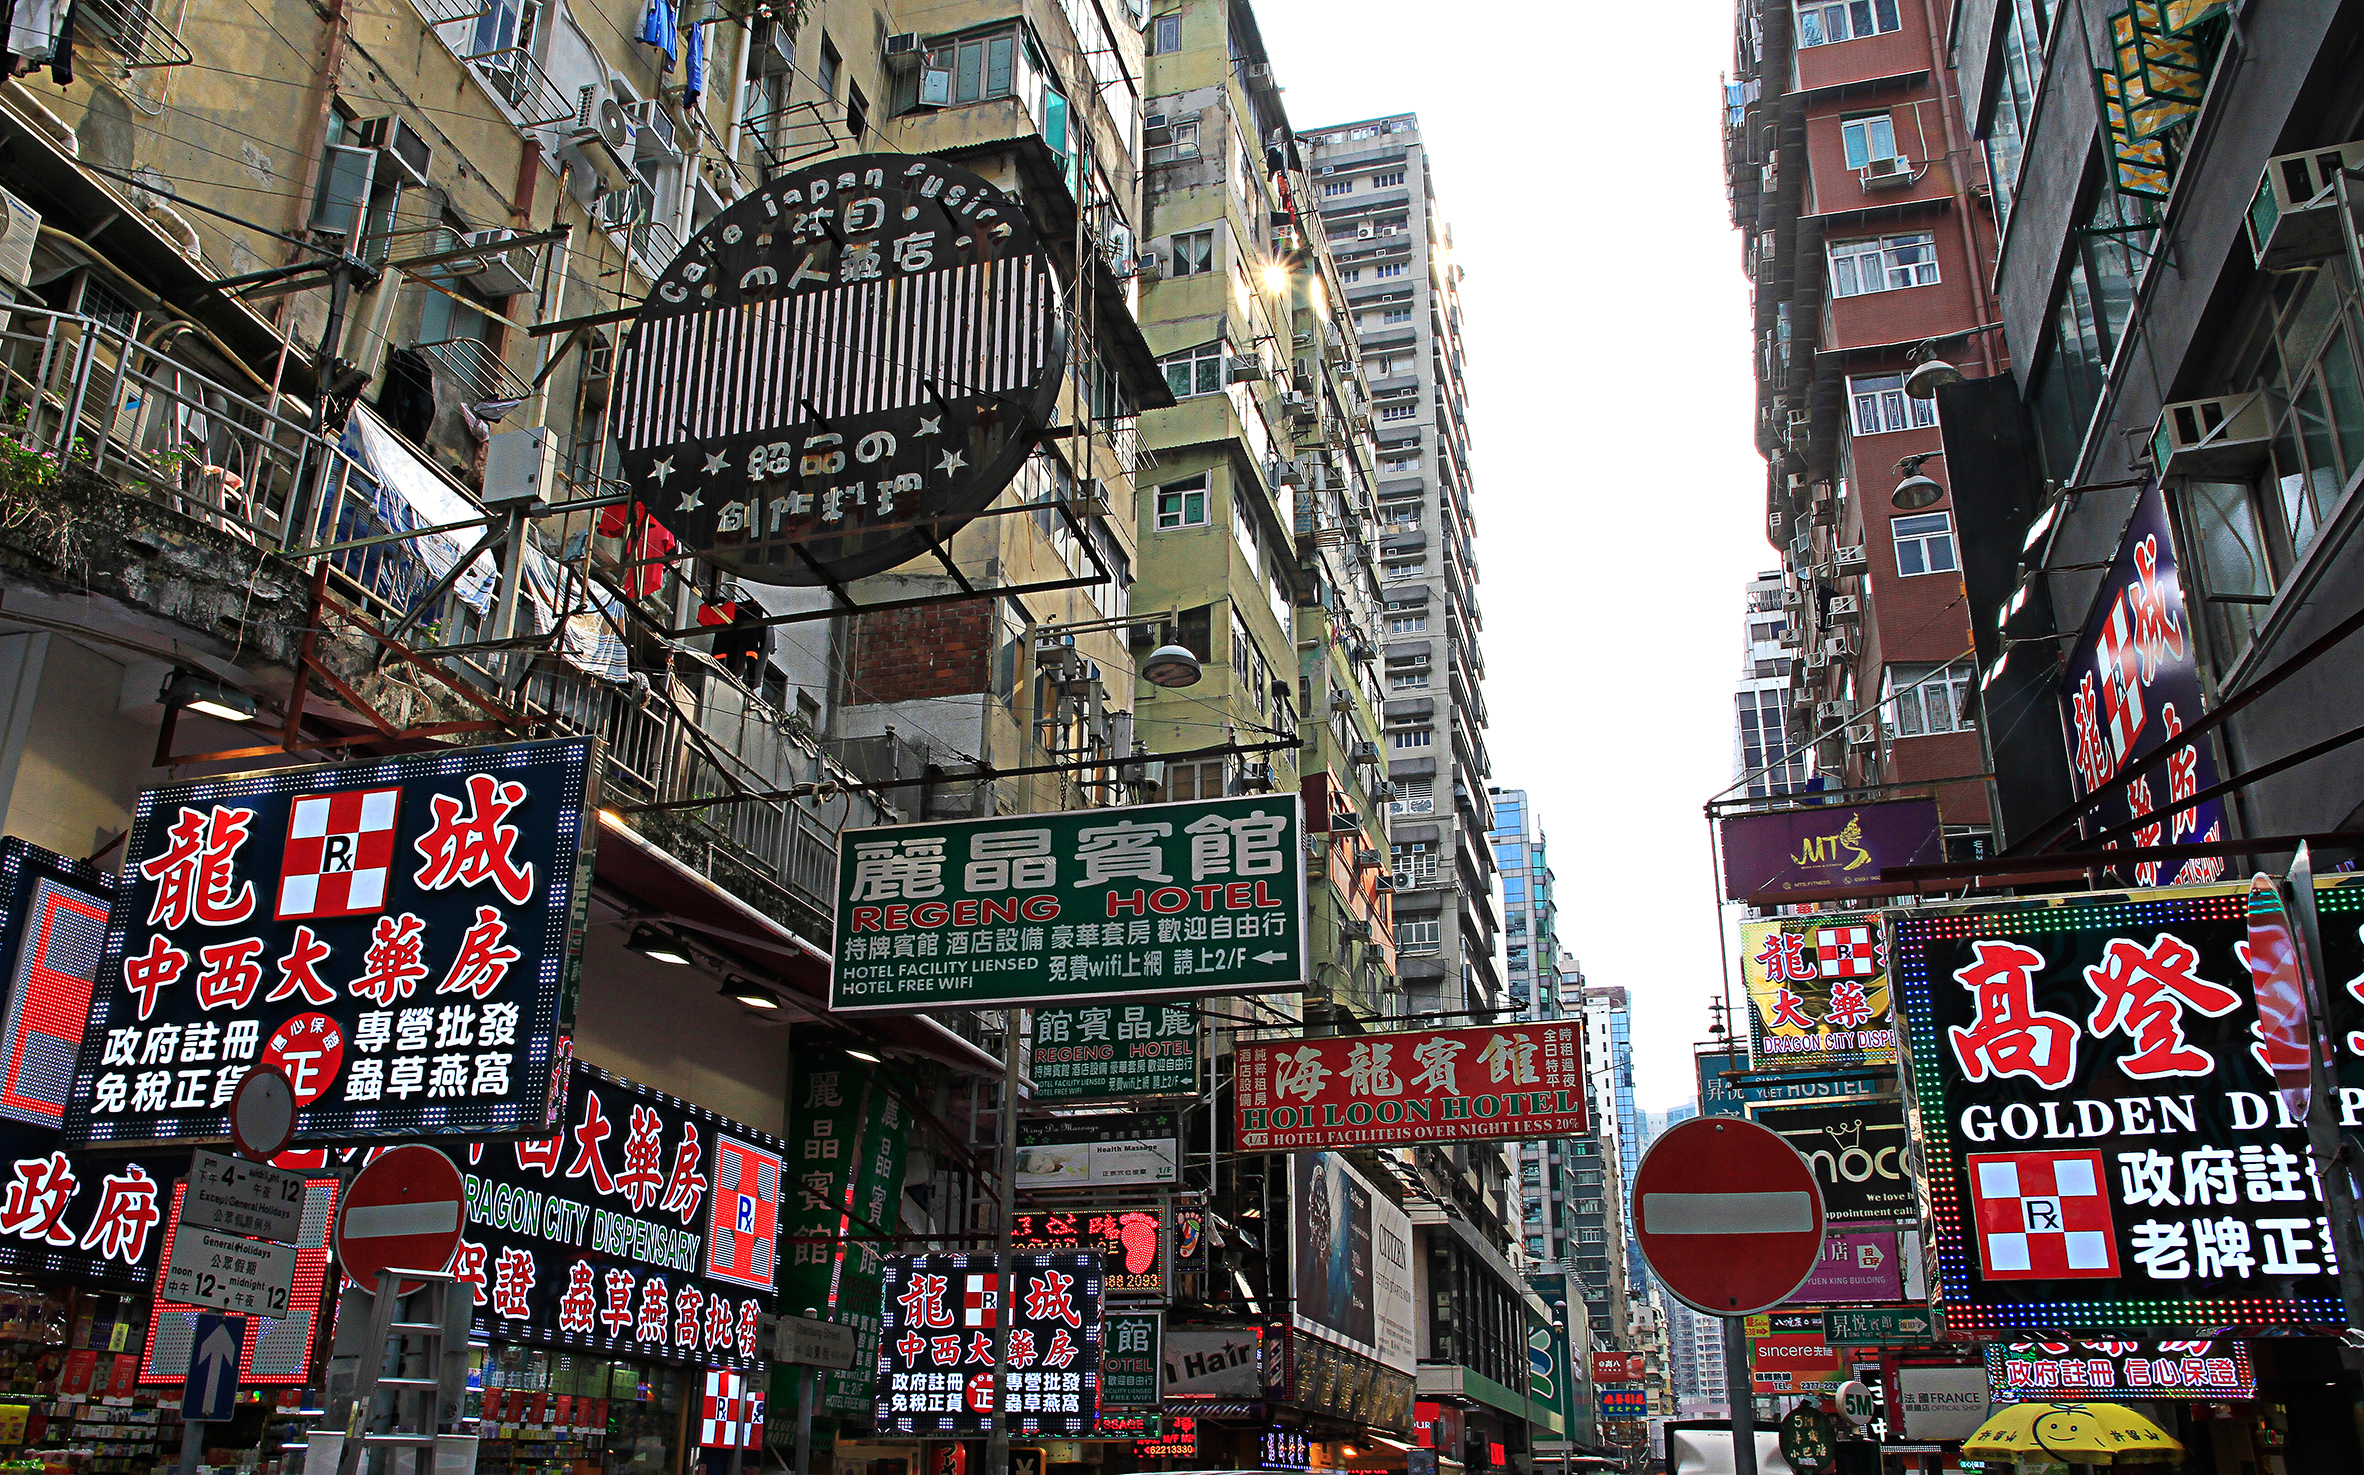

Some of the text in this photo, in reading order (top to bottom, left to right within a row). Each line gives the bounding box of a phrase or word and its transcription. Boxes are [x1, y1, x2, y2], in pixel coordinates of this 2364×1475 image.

[141, 773, 534, 930] 龍 城
[849, 809, 1288, 902] 麗晶賓館
[851, 880, 1282, 933] REGENG HOTEL
[844, 911, 1287, 961] 持牌賓館 酒店設備 豪華套房 歡迎自由行
[124, 904, 521, 1021] 中西大藥房
[843, 956, 1039, 980] HOTEL FACILITY LIENSED
[1754, 933, 1817, 982] 龍
[842, 974, 973, 996] HOTEL FREE WIFI
[353, 1001, 520, 1053] 專營批發
[100, 1020, 259, 1068] 政府註冊
[1035, 1040, 1194, 1063] REGENG HOTEL
[1763, 1033, 1821, 1054] DRAGON
[1824, 1031, 1855, 1051] CITY
[282, 1050, 323, 1097] 正
[344, 1053, 511, 1103] 蟲草燕窩
[1275, 1033, 1541, 1102] 海龍賓館
[1756, 1089, 1782, 1099] YUET
[1240, 1089, 1579, 1131] HOI LOON HOTEL
[1960, 1094, 2198, 1142] GOLDEN
[1274, 1132, 1325, 1146] HOTEL
[1414, 1125, 1457, 1139] OVER
[1459, 1121, 1510, 1137] NIGHT
[1513, 1118, 1553, 1132] LESS
[1555, 1116, 1580, 1131] 20%
[1097, 1144, 1157, 1153] Health Massage
[204, 1156, 218, 1169] pm
[282, 1178, 300, 1202] 12
[1867, 1191, 1905, 1202] We love
[0, 1152, 160, 1264] 政府
[199, 1190, 228, 1205] Except
[258, 1200, 291, 1219] Holidays
[461, 1173, 701, 1274] RAGON CITY DISPENSARY
[203, 1235, 272, 1259] General Holidays
[171, 1265, 193, 1278] noon
[1127, 1274, 1158, 1287] 2093
[1850, 1276, 1886, 1284] BUILDING
[168, 1281, 190, 1296] 中午
[229, 1277, 266, 1291] midnight
[267, 1285, 287, 1310] 12
[897, 1270, 1082, 1329] 龍 城
[1184, 1341, 1251, 1379] Hair
[1759, 1346, 1813, 1357] sincere
[1105, 1358, 1153, 1372] OTEL
[2006, 1357, 2239, 1388] 政府註冊 信心保證
[892, 1372, 964, 1392] 政府註冊
[1005, 1372, 1080, 1392] 專營批發
[891, 1393, 963, 1412] 免稅正貨
[1004, 1393, 1080, 1413] 蟲草燕窩
[1846, 1394, 1873, 1416] 5M
[1931, 1393, 1980, 1403] FRANCE
[1931, 1404, 1960, 1412] OPTICAL
[1103, 1419, 1144, 1430] SSAGE
